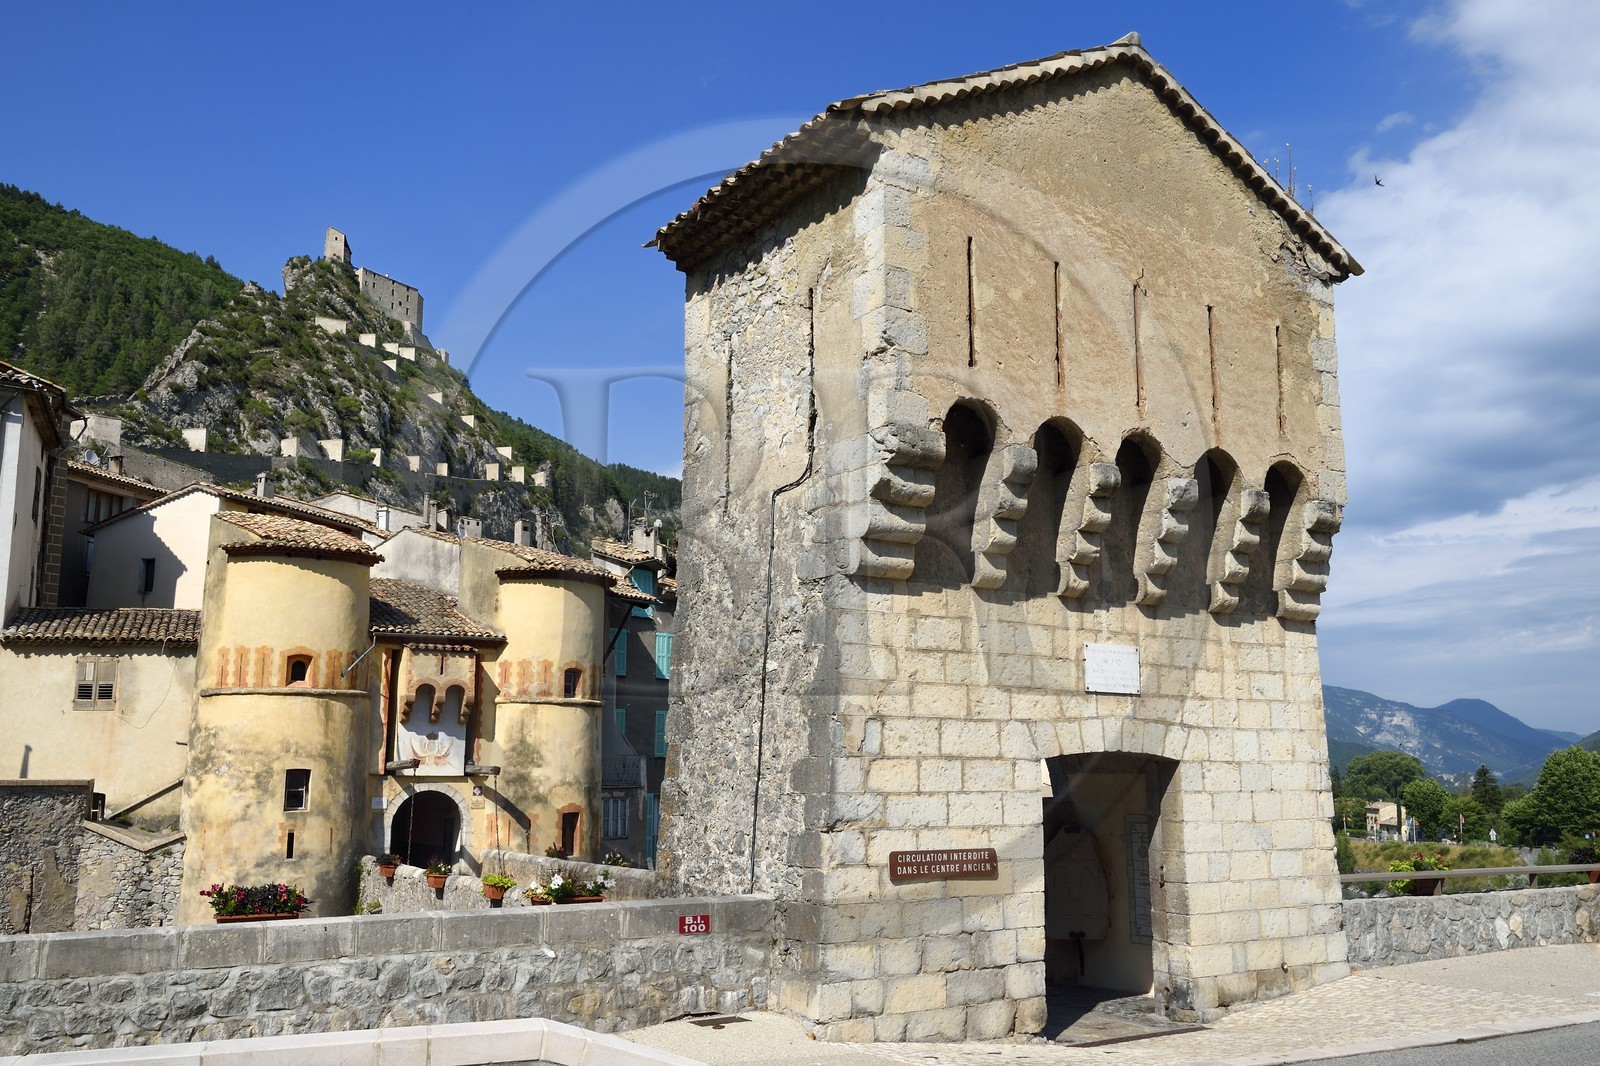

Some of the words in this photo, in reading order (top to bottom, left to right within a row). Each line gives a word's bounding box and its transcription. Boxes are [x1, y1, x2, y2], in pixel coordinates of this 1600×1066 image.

[897, 853, 948, 863] CIRCULATION
[950, 851, 989, 861] INTERDITE
[897, 866, 918, 875] DANS
[920, 865, 929, 874] LE
[931, 864, 960, 874] CENTRE
[685, 916, 705, 924] B.I.
[683, 924, 706, 933] 100
